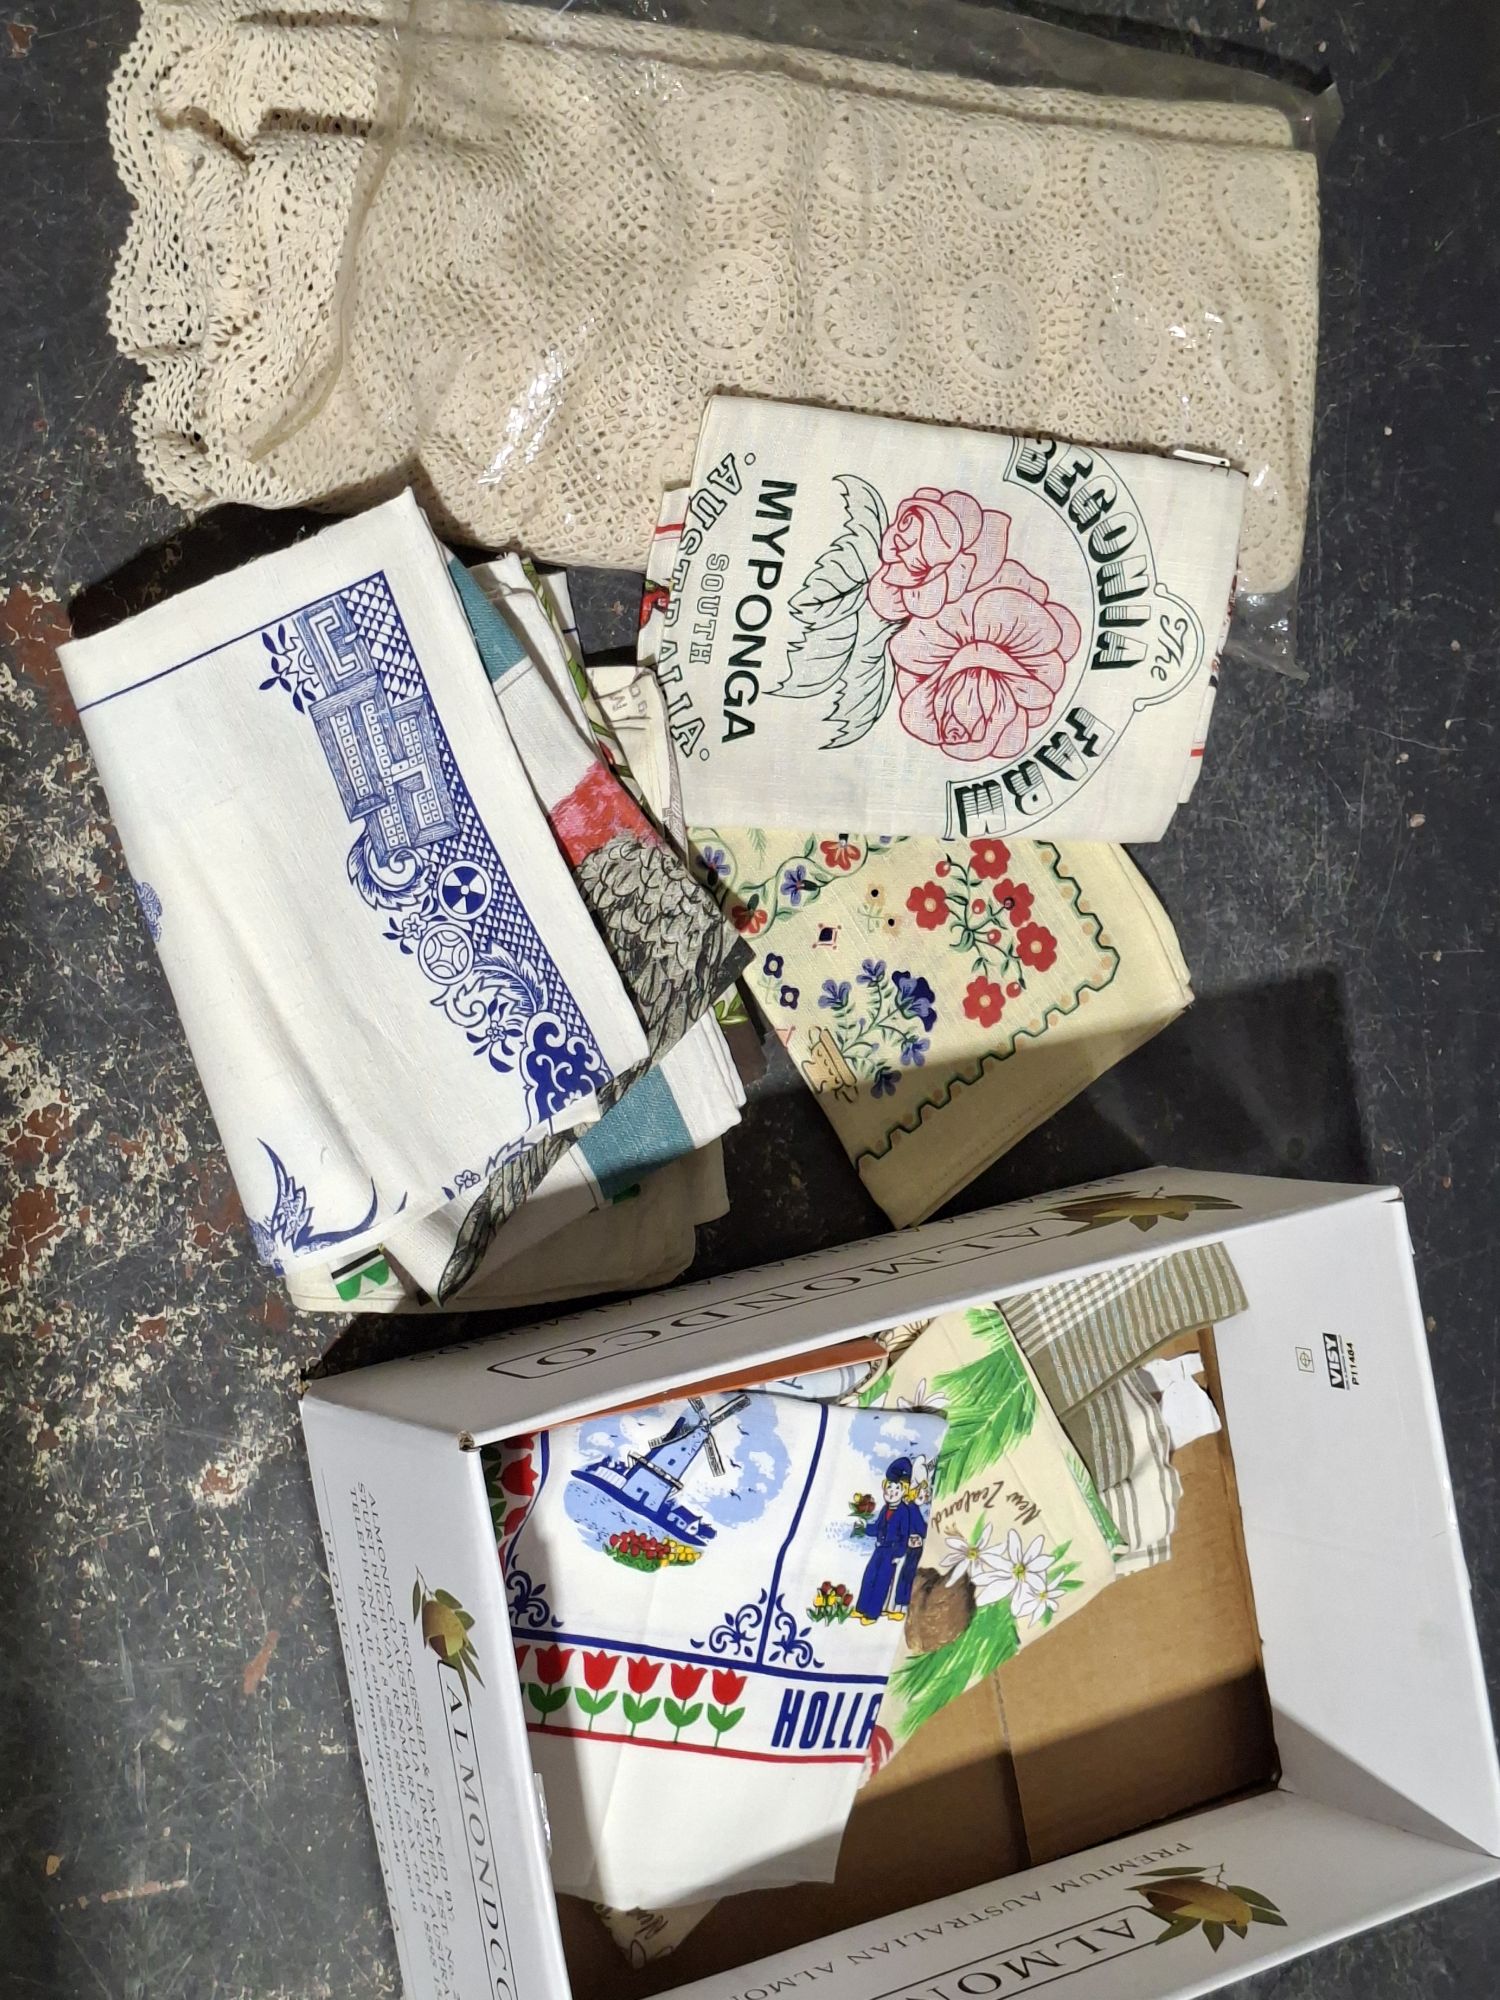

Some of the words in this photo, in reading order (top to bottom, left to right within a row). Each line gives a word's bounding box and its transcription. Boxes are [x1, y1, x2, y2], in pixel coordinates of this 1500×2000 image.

[689, 552, 729, 664] SOUTH
[721, 479, 798, 744] MYPONGA
[1014, 437, 1151, 671] BEGONIA
[1150, 615, 1190, 682] The
[955, 706, 1116, 838] FARM
[536, 1227, 1041, 1365] ALMONDCO
[1324, 1334, 1343, 1387] VISY
[348, 1485, 378, 1625] TELEPHONE
[931, 1481, 1004, 1533] Zealand
[1006, 1492, 1042, 1525] New
[356, 1583, 375, 1657] EMAIL
[368, 1491, 398, 1635] ALMONDCO
[392, 1640, 420, 1774] AUSTRALIA
[324, 1531, 355, 1681] PRODUCT
[353, 1697, 365, 1738] OF
[363, 1753, 400, 1932] AUSTRALIA
[357, 1481, 375, 1555] STURT
[414, 1817, 433, 1897] SOUTH
[398, 1619, 427, 1755] PROCESSED
[426, 1787, 448, 1882] PACKED
[846, 1891, 1042, 1966] AUSTRALIAN
[1051, 1843, 1193, 1894] PREMIUM
[732, 1961, 834, 2000] ALMO
